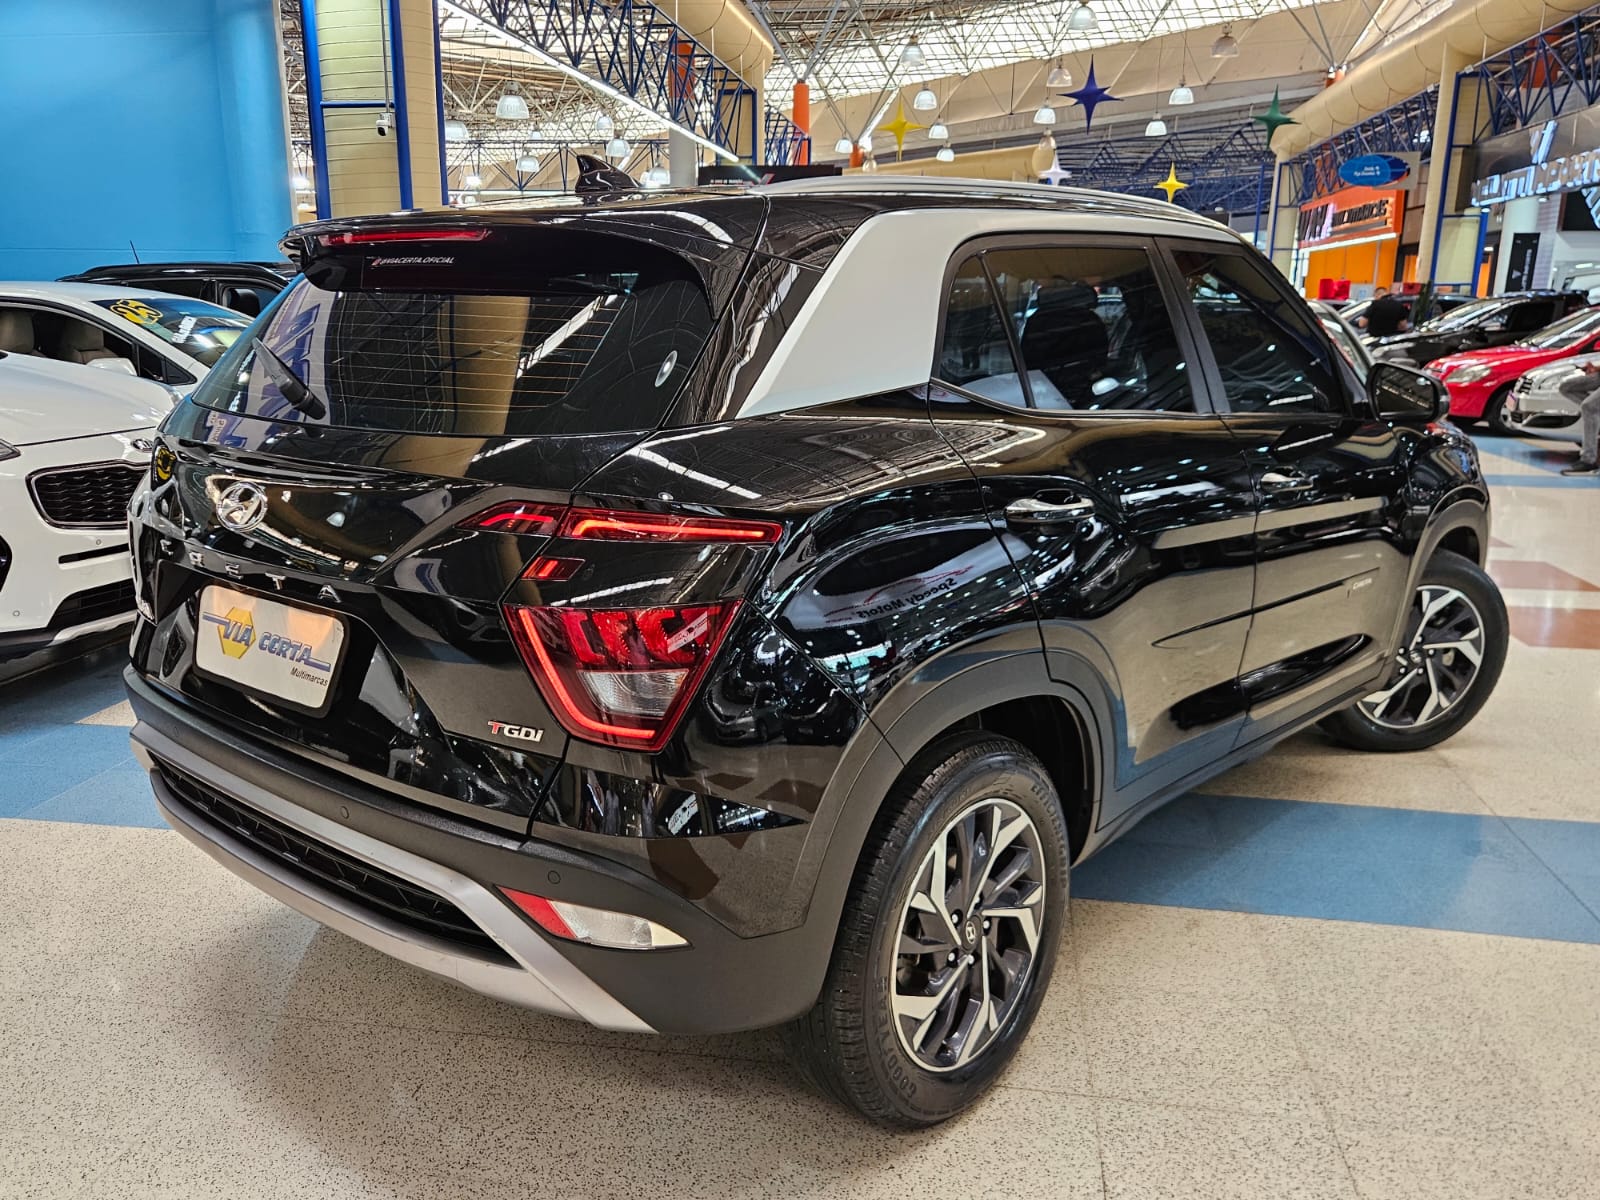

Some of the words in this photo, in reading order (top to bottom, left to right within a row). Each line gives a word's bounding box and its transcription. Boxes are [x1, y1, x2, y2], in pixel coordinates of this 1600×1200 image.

[160, 538, 342, 604] CRETA
[223, 619, 254, 646] VIA
[258, 631, 313, 667] CERTA
[290, 666, 329, 687] Multimarcas
[487, 720, 545, 743] TGDI
[876, 976, 918, 1098] GOODYEAR
